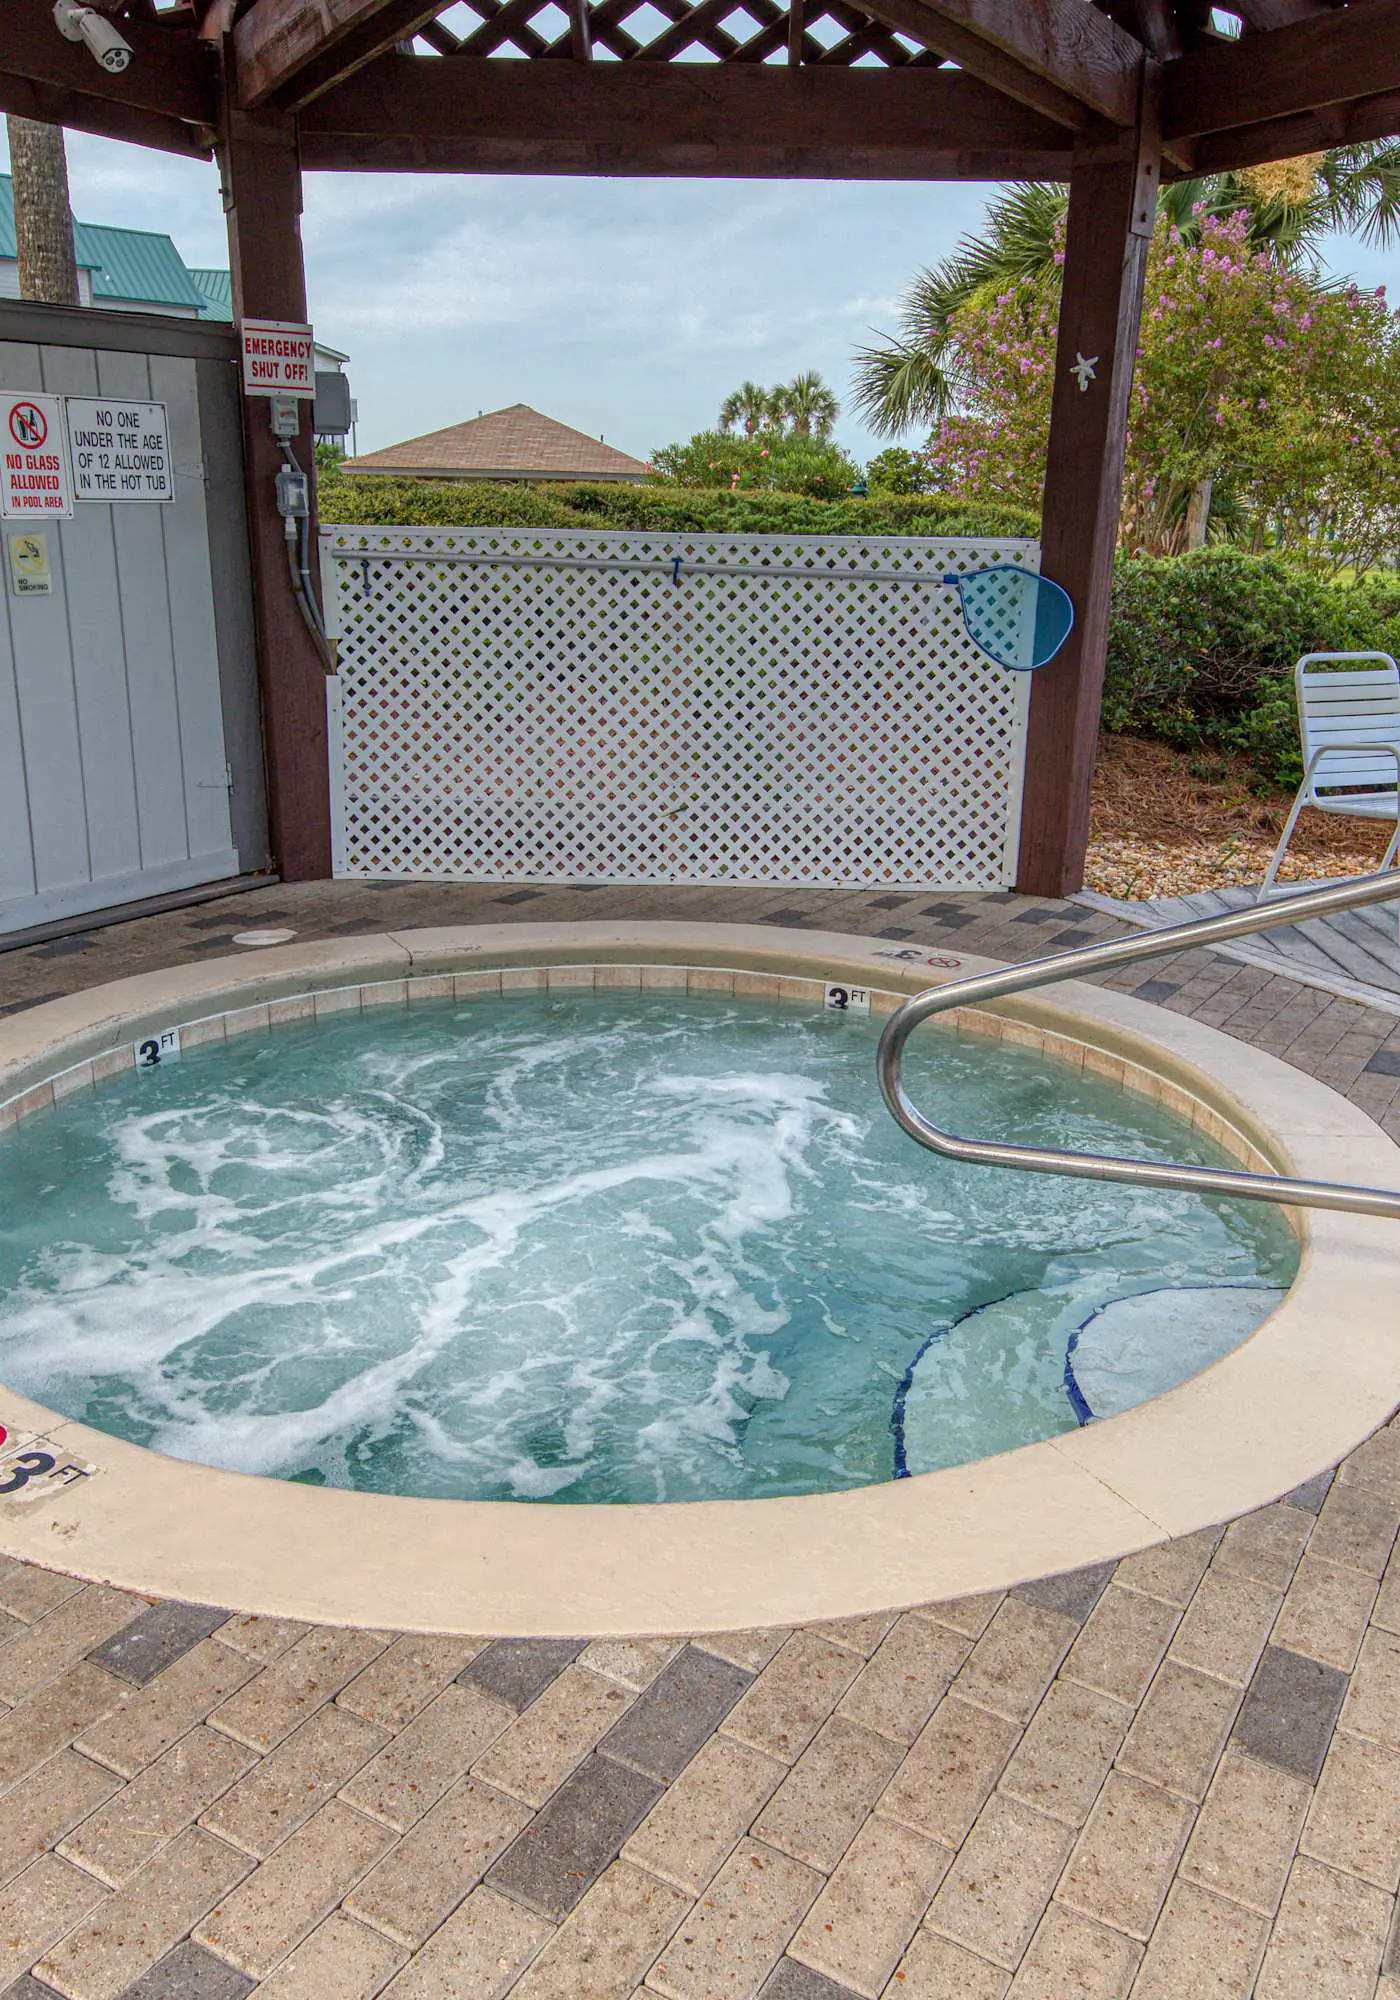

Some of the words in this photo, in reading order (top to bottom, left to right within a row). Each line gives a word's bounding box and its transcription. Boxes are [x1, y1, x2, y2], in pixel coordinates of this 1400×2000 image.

[244, 336, 312, 359] EMERGENCY
[251, 359, 280, 379] SHUT
[284, 363, 308, 381] OFF!
[96, 410, 113, 427] NO
[117, 411, 140, 428] ONE
[74, 430, 114, 448] UNDER
[116, 433, 139, 449] THE
[142, 434, 164, 450] AGE
[5, 453, 23, 470] NO
[25, 454, 60, 471] GLASS
[78, 452, 94, 469] OF
[98, 454, 110, 469] 12
[114, 454, 164, 471] ALLOWED
[10, 474, 60, 490] ALLOWED
[80, 473, 91, 489] IN
[94, 474, 117, 490] THE
[120, 474, 142, 490] HOT
[145, 475, 166, 490] TUB
[11, 495, 21, 508] IN
[23, 495, 43, 508] POOL
[44, 495, 64, 508] AREA
[828, 987, 849, 1010] 3
[851, 989, 866, 1004] FT
[139, 1039, 162, 1068] 3
[160, 1031, 175, 1049] FT
[0, 1451, 57, 1495] 3
[48, 1464, 91, 1486] FT
